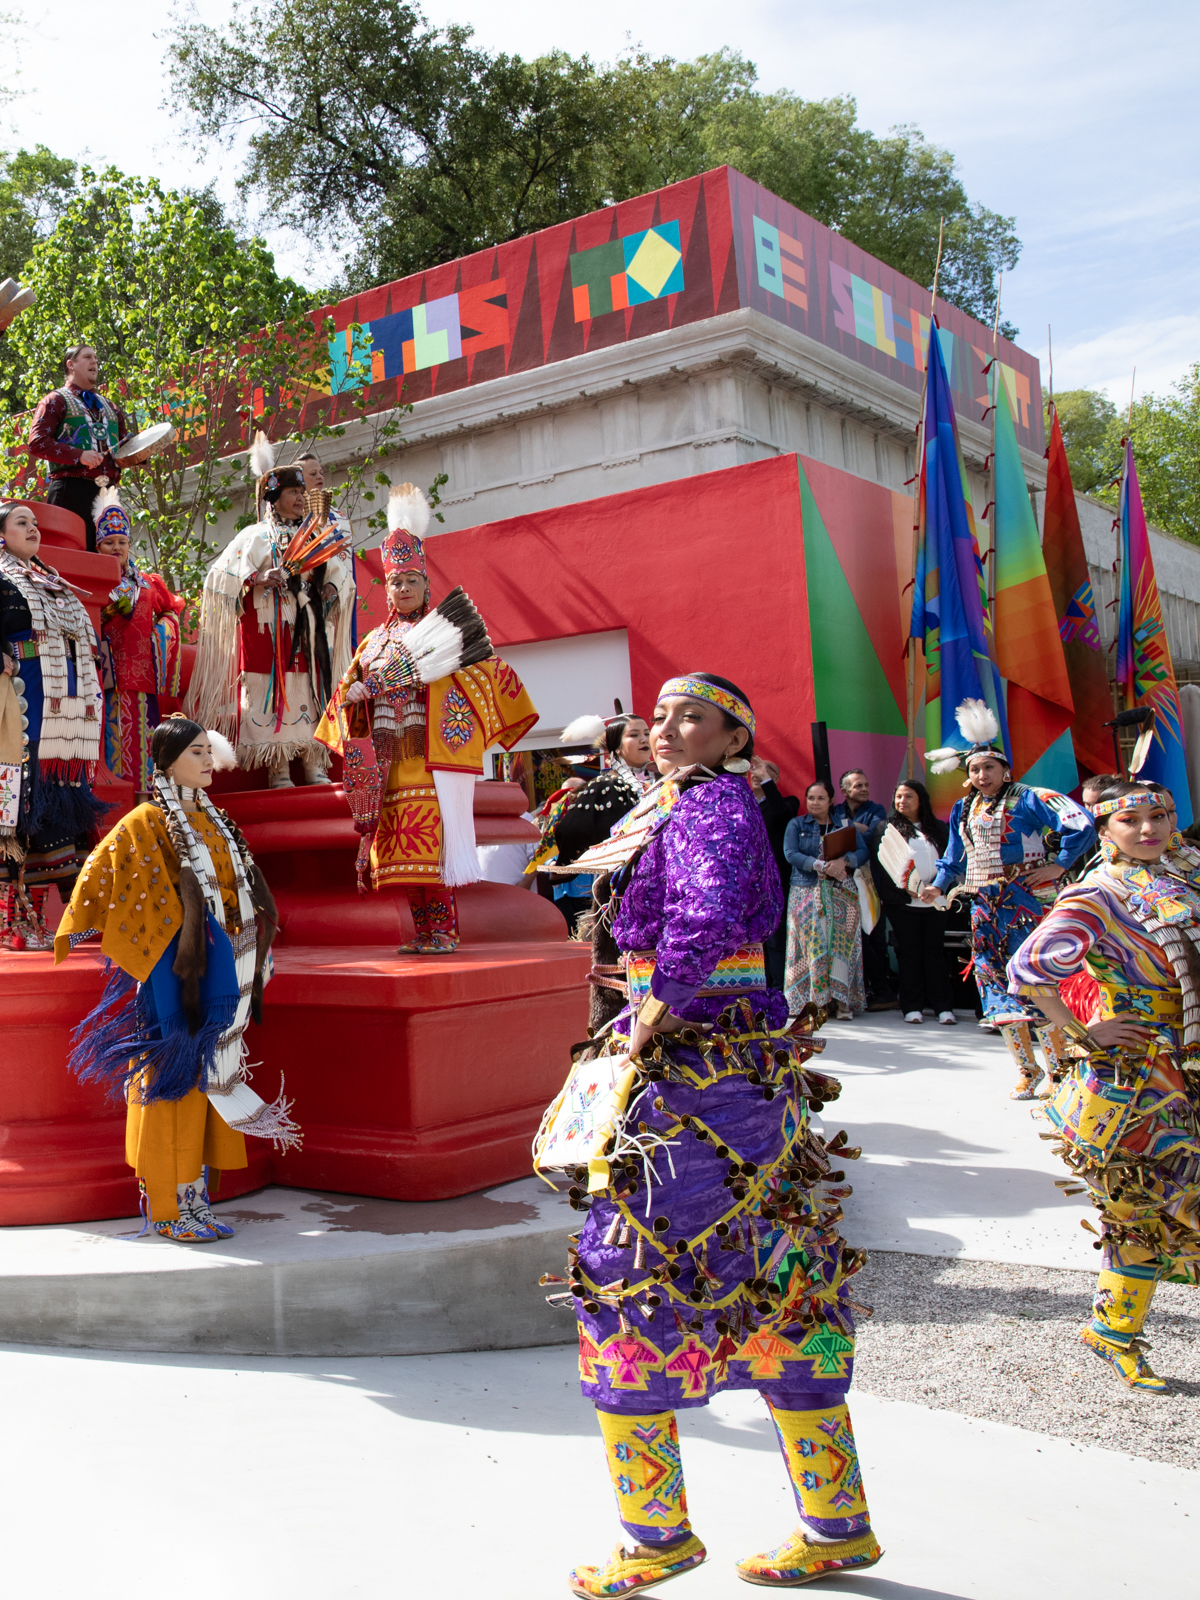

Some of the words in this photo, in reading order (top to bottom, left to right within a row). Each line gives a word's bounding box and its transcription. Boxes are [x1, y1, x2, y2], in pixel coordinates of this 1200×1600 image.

[569, 219, 685, 323] TO
[752, 214, 808, 312] BE
[535, 779, 565, 790] RIGHT
[538, 771, 566, 780] CIVIL
